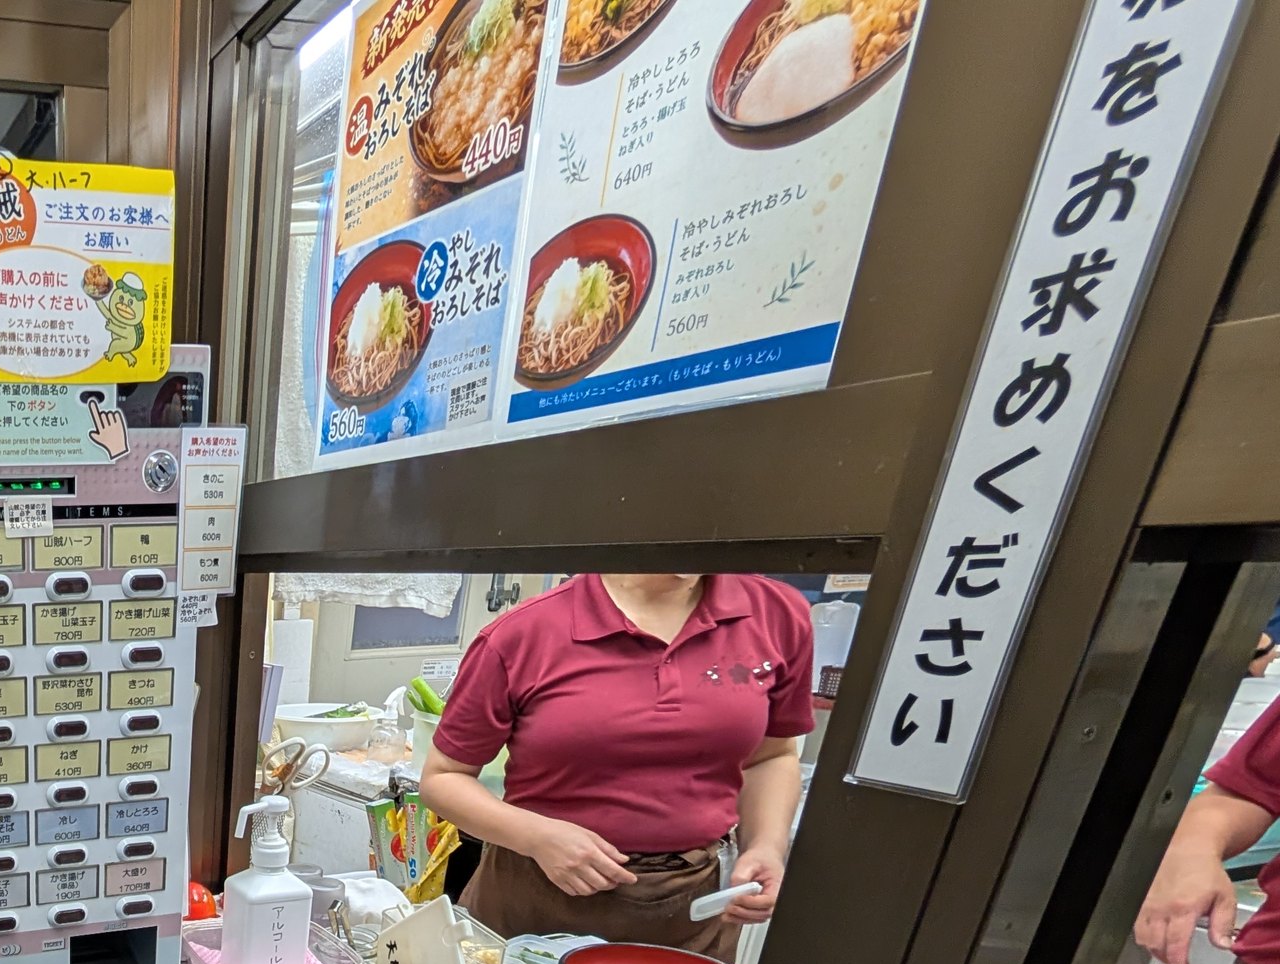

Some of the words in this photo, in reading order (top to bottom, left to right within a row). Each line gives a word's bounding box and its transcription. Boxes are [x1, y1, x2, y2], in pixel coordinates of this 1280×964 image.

[627, 40, 702, 93] 冷やしとろろ
[374, 50, 425, 121] みぞれ
[625, 74, 690, 113] そば・うどん
[364, 72, 435, 160] おろしそば
[348, 106, 370, 148] 温
[463, 119, 522, 176] 440円
[618, 131, 654, 158] ねぎ入り
[614, 161, 653, 190] 640円
[45, 202, 170, 225] ご注文のお客様へ
[682, 184, 809, 241] 冷やしみぞれおろし
[85, 232, 130, 250] お願い
[679, 227, 751, 262] そば・うどん
[421, 249, 445, 292] 冷
[449, 231, 473, 256] やし
[444, 244, 501, 293] みぞれ
[675, 258, 734, 286] みぞれおろし
[671, 282, 710, 304] ねぎ入り
[431, 275, 507, 327] おろしそば
[8, 318, 74, 331] システムの都合で
[666, 313, 709, 337] 560円
[890, 0, 1185, 747] をお求めください
[7, 400, 57, 412] 下のボタン
[329, 409, 365, 442] 560円
[12, 438, 29, 447] press
[30, 437, 40, 445] the
[41, 437, 62, 445] button
[62, 436, 81, 444] below
[191, 436, 237, 447] 購入希望の方は
[21, 448, 28, 456] of
[29, 448, 39, 456] the
[54, 449, 67, 458] you
[187, 448, 240, 458] お声かけください
[203, 474, 225, 485] きのこ
[203, 490, 224, 500] 530円
[65, 506, 124, 517] ITEMS
[208, 516, 216, 527] 肉
[43, 535, 93, 548] 山賊ハーフ
[140, 534, 150, 546] 鴨
[202, 533, 221, 542] 600円
[53, 555, 83, 566] 800円
[130, 554, 158, 564] 610円
[199, 557, 220, 568] もつ煮
[200, 573, 219, 582] 600円
[40, 606, 77, 618] かき揚げ
[114, 607, 171, 620] かき揚げ山菜
[61, 616, 97, 628] 山菜玉子
[53, 631, 82, 641] 780円
[128, 626, 156, 637] 720円
[41, 677, 94, 690] 野沢菜わさび
[128, 678, 155, 690] きつね
[76, 688, 94, 698] 昆布
[54, 701, 83, 712] 530円
[127, 695, 154, 706] 490円
[59, 749, 78, 761] ねぎ
[130, 743, 149, 755] かけ
[54, 766, 82, 777] 410円
[126, 760, 153, 771] 360円
[116, 806, 159, 819] 冷しとろろ
[58, 815, 78, 826] 冷し
[124, 823, 150, 834] 640円
[54, 830, 81, 841] 600円
[122, 867, 147, 878] 大盛り
[408, 857, 417, 879] 50
[50, 871, 86, 883] かき揚げ
[119, 882, 151, 894] 170円増
[55, 890, 81, 900] 190円
